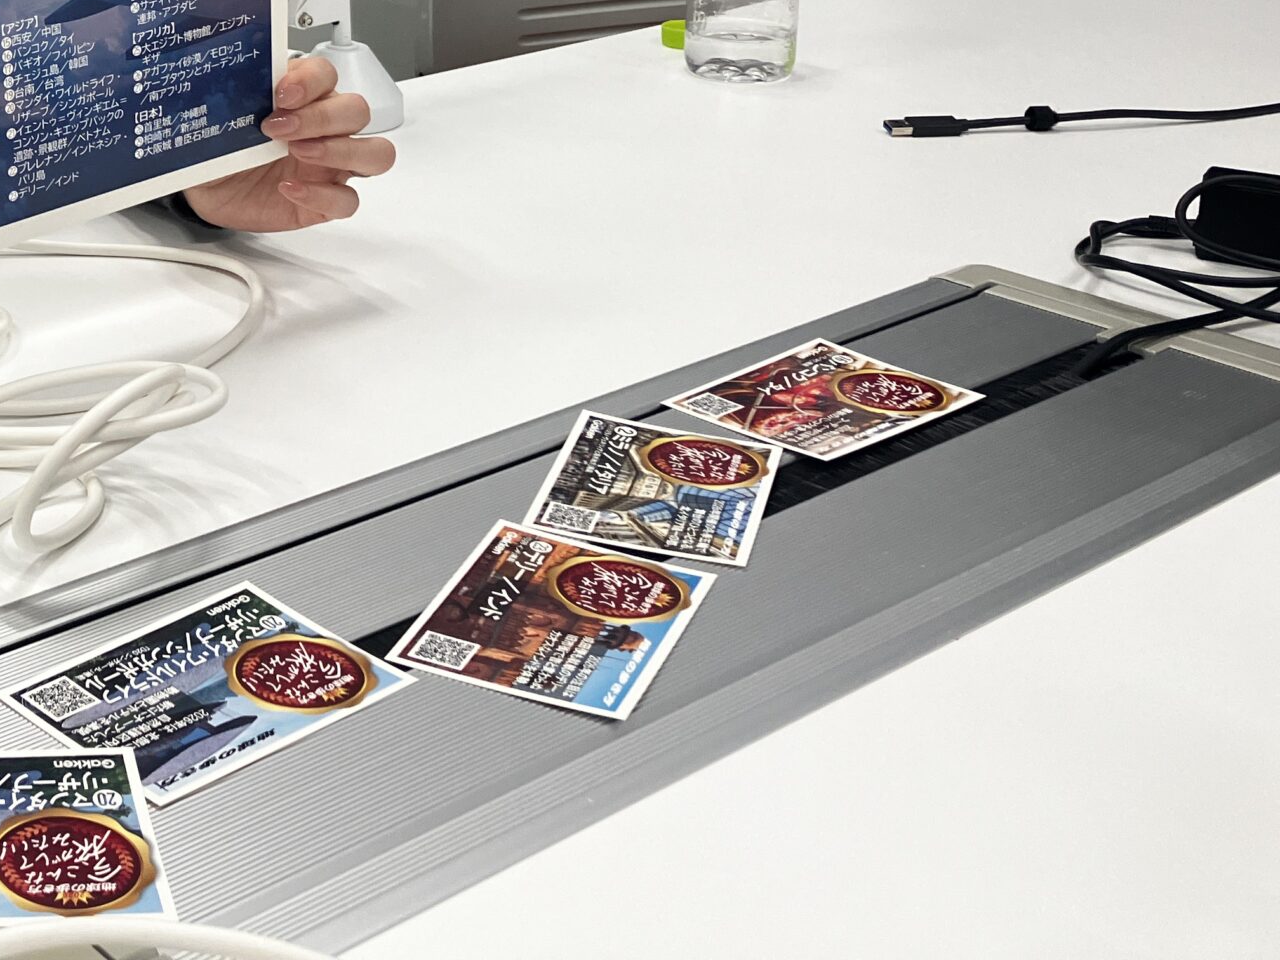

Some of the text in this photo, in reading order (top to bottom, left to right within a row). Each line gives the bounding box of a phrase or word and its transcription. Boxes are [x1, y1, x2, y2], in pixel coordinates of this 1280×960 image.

[142, 52, 160, 65] ギザ
[18, 169, 46, 186] バリ島
[52, 759, 116, 769] Gakken
[26, 881, 118, 893] 地球の歩き方
